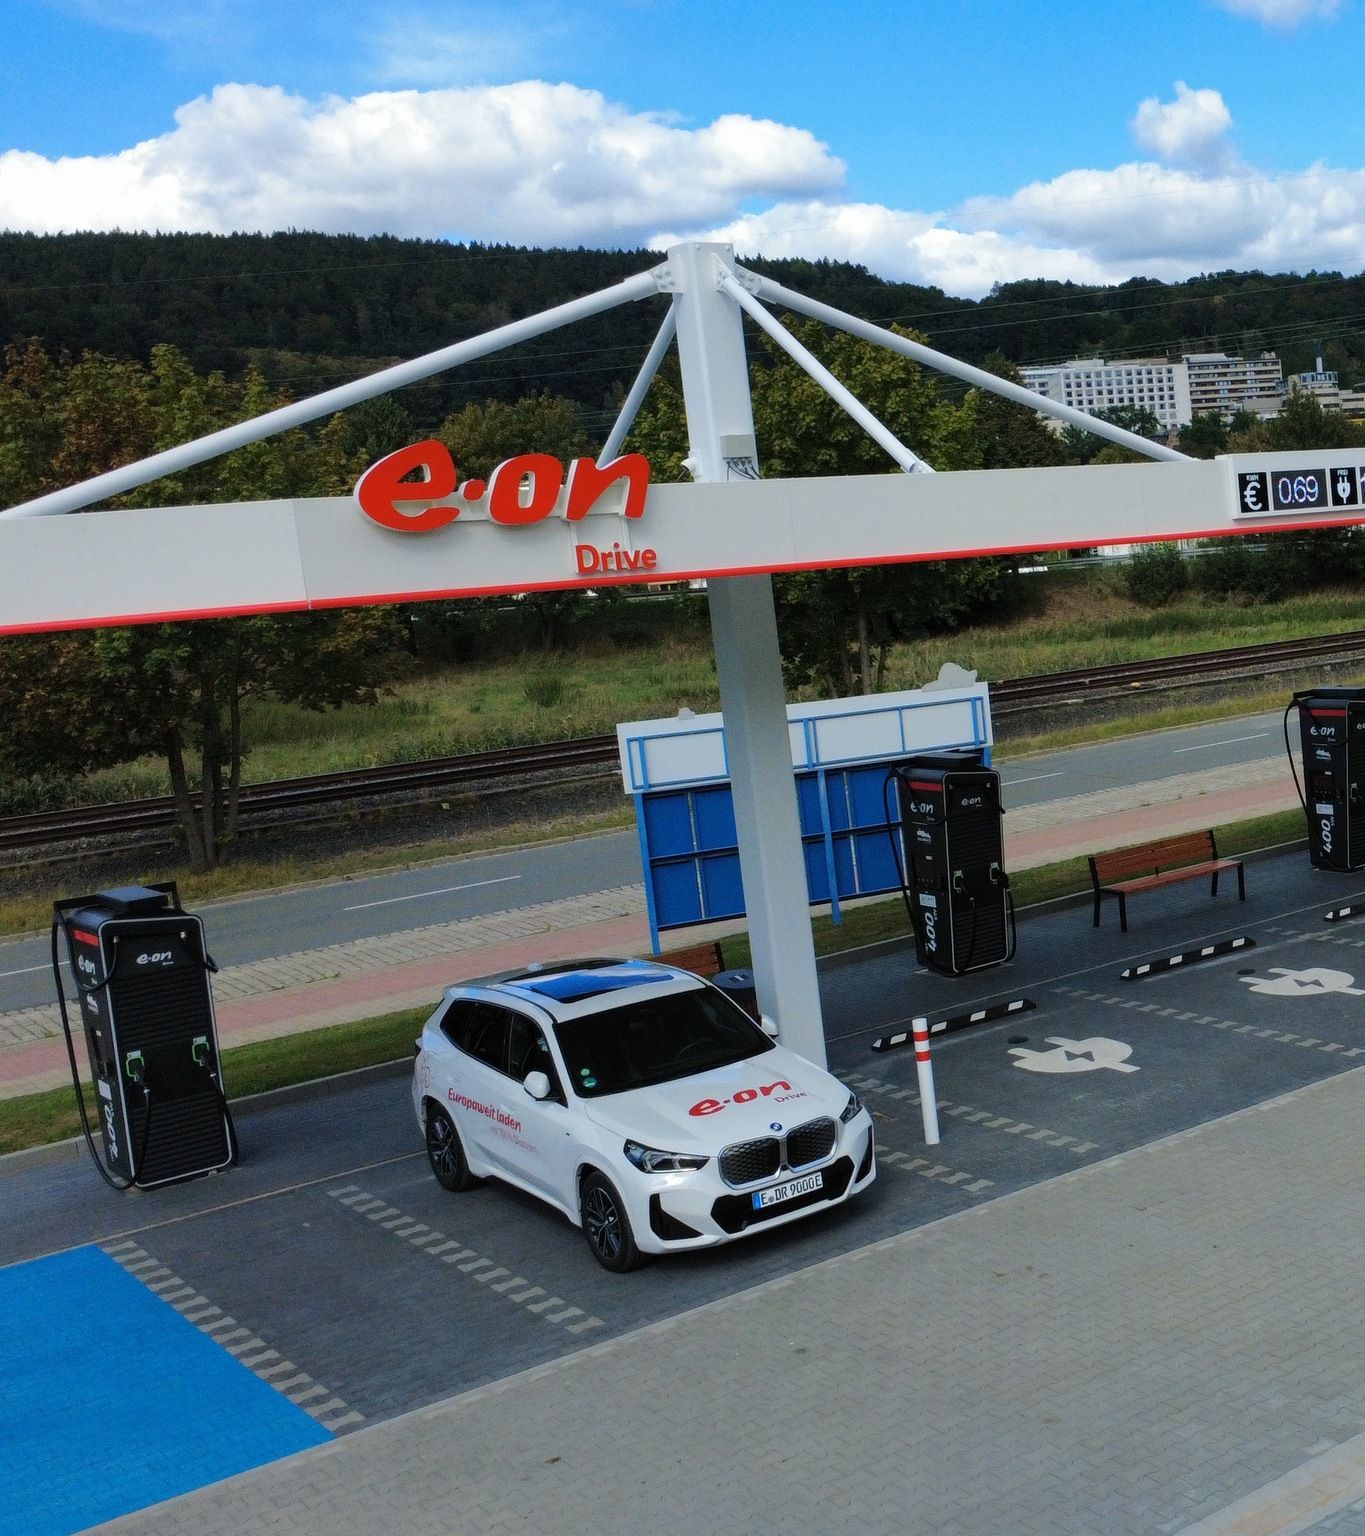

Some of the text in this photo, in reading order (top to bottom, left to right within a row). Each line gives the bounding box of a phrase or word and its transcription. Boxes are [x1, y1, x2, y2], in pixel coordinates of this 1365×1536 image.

[1243, 475, 1319, 511] € 0.69
[574, 542, 658, 576] Drive
[1321, 819, 1332, 853] 400
[925, 912, 937, 952] 400
[447, 1087, 522, 1133] Europaweit laden
[774, 1091, 808, 1103] Drive
